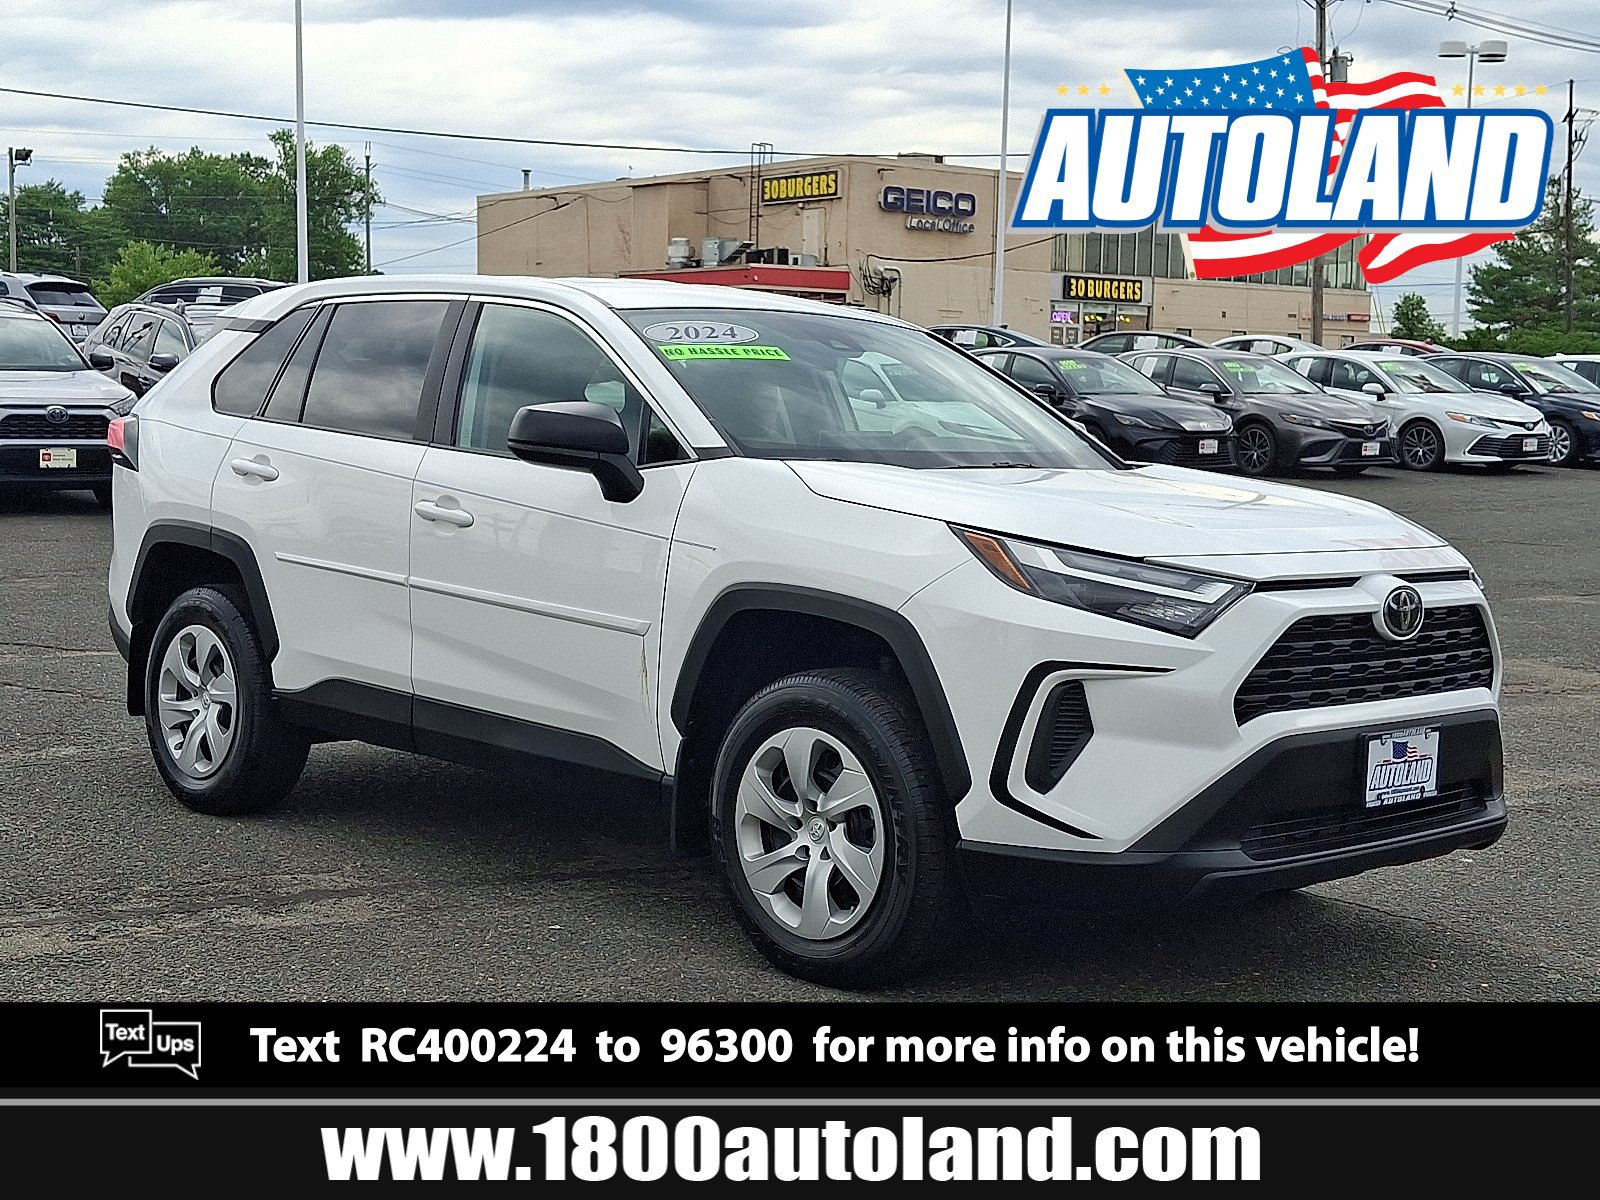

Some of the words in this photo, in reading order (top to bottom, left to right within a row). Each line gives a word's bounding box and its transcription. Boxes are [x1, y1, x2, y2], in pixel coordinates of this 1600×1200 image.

[881, 185, 977, 217] GEICO
[906, 215, 940, 231] Local
[943, 218, 975, 233] Office
[1070, 277, 1085, 297] 30
[1087, 279, 1141, 301] BURGERS
[665, 325, 738, 341] 2024
[664, 347, 685, 356] NO
[688, 347, 741, 356] HASSLE
[743, 348, 784, 357] PRICE
[1370, 758, 1433, 791] AUTOLAND
